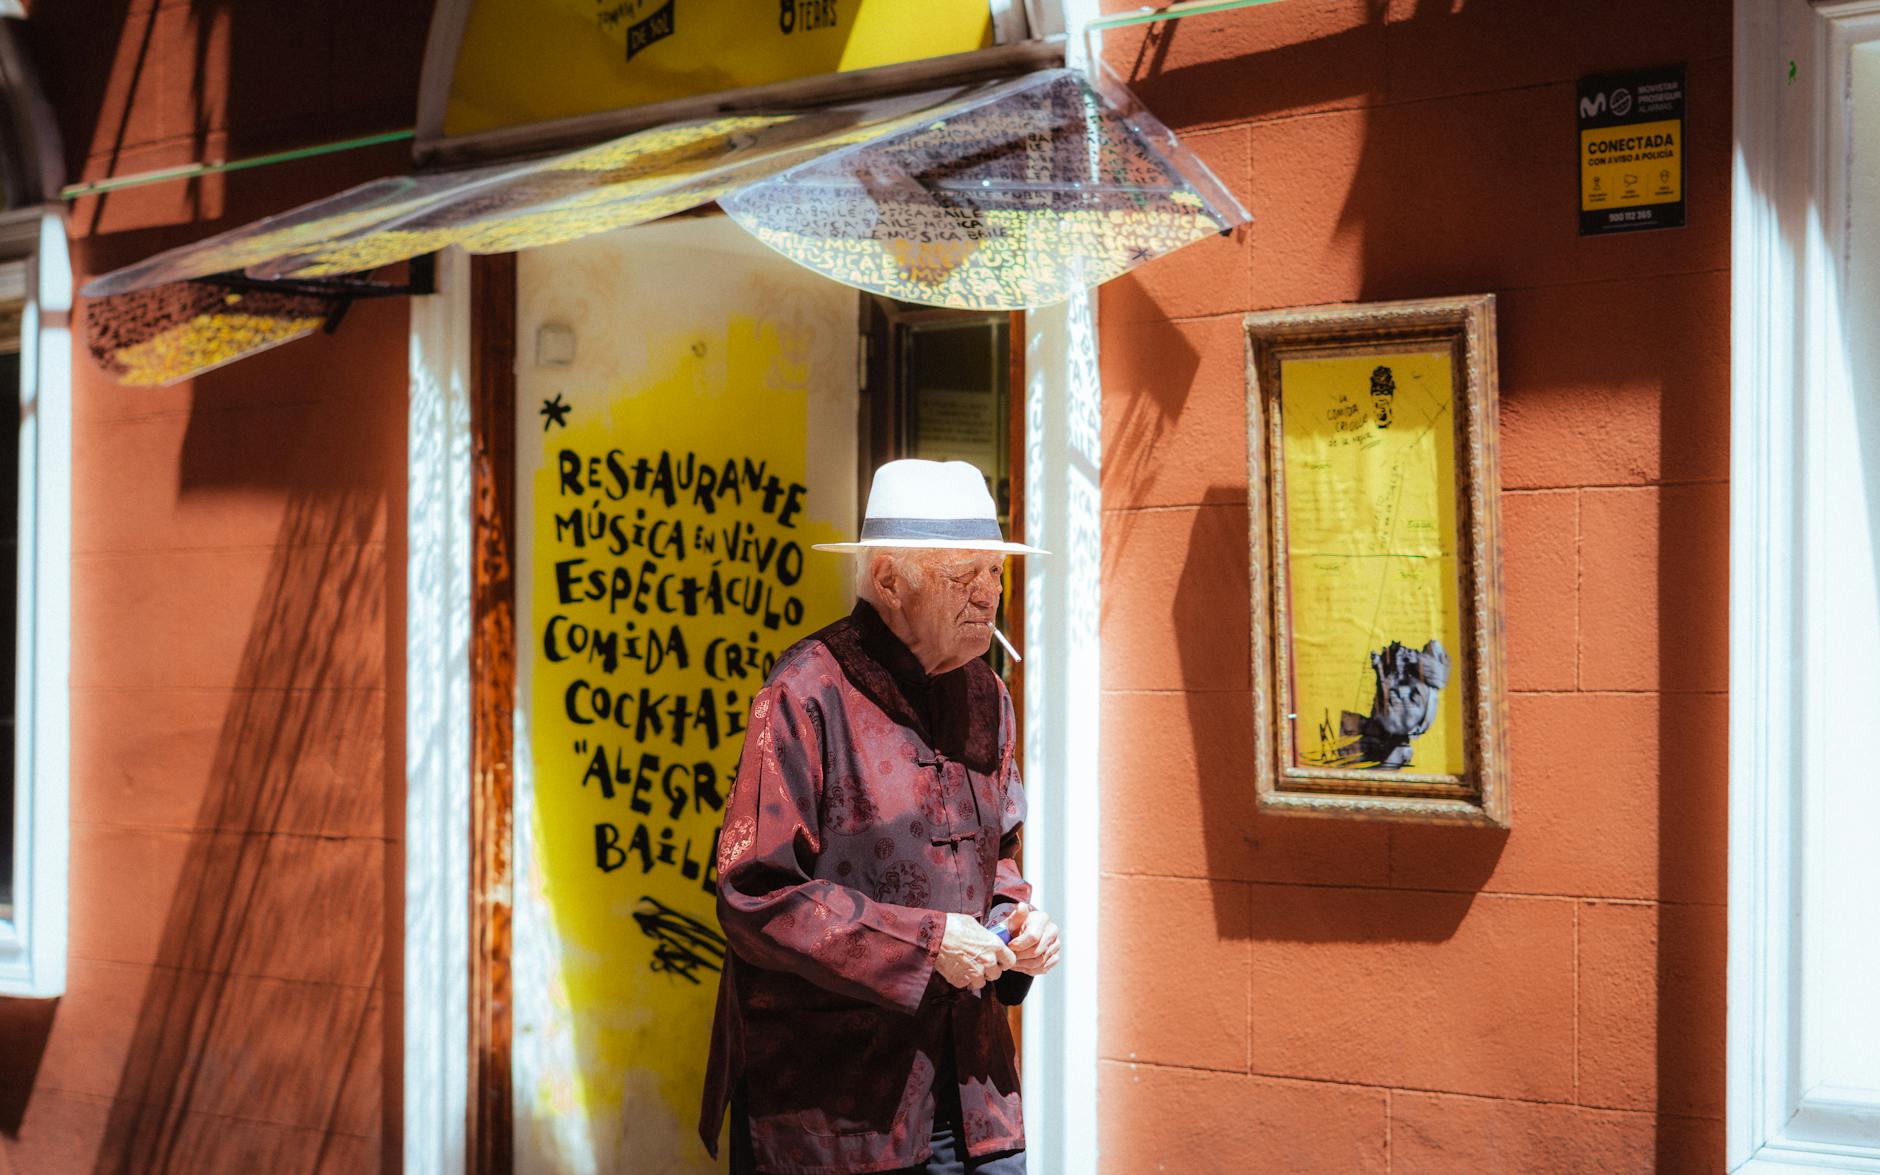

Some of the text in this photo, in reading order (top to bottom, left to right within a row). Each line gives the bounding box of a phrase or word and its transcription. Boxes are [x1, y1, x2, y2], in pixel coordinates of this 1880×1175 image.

[1637, 82, 1679, 95] MOVISTAR
[1637, 91, 1682, 104] PROSEGUR
[1588, 133, 1674, 155] CONECTADA
[1588, 157, 1608, 167] CON
[1608, 154, 1634, 165] AVISO
[1641, 148, 1674, 161] POLICÍA
[1608, 213, 1625, 223] 900
[559, 449, 807, 528] RESTAURANTE
[555, 500, 804, 586] MÚSICA EN VIVO
[555, 558, 804, 630] ESPECTÁCULO
[544, 615, 775, 682] COMIDA CRIO
[565, 679, 754, 750] COCKTAI
